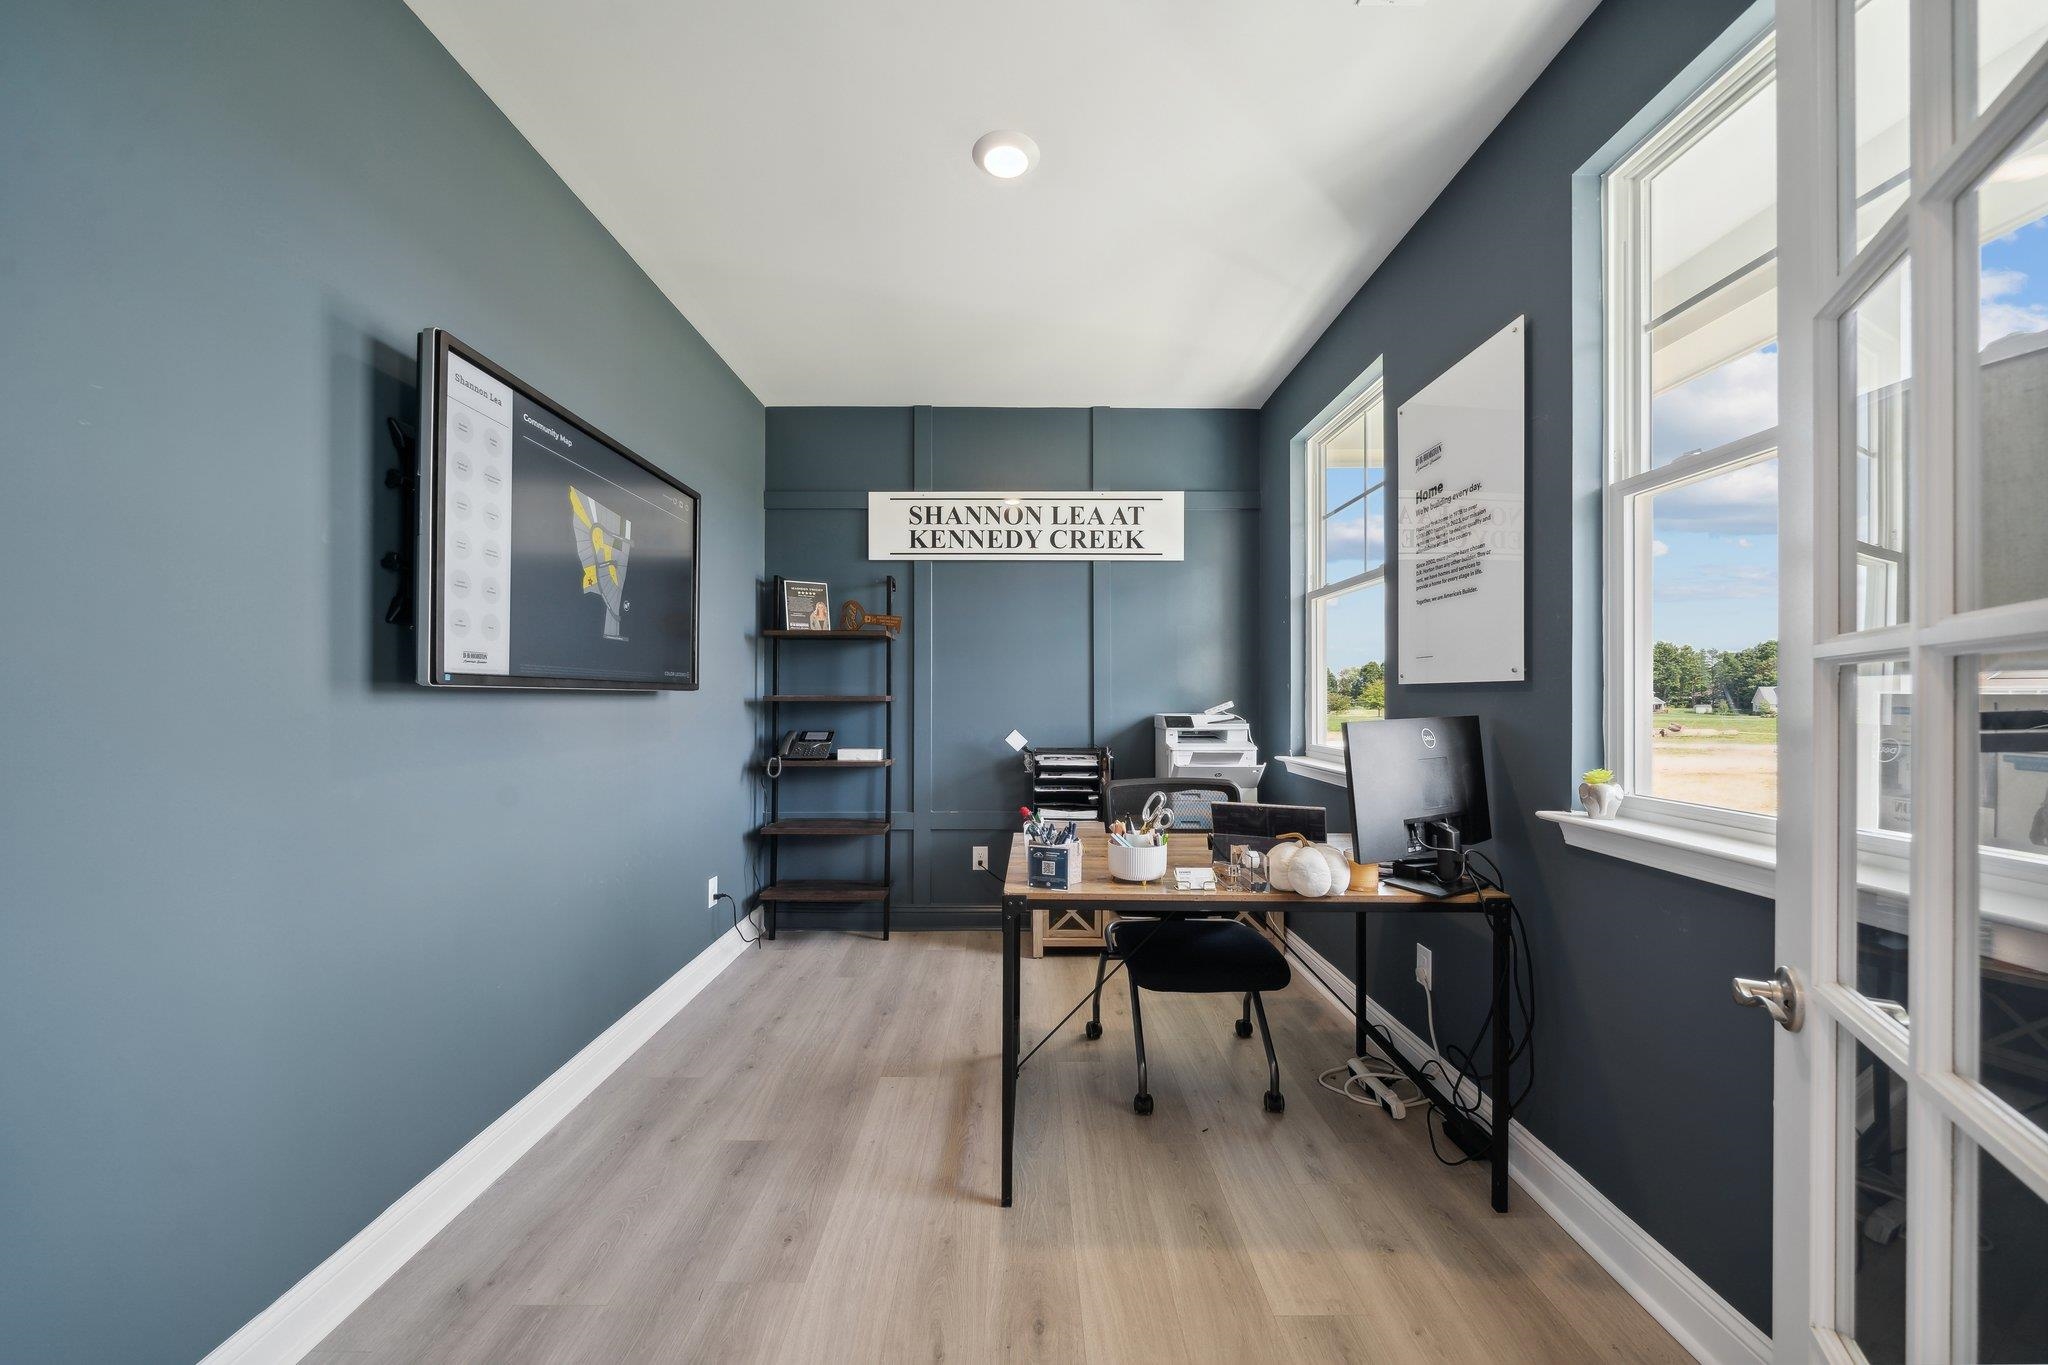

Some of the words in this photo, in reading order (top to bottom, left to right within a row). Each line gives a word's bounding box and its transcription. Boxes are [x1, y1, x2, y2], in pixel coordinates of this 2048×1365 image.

[454, 372, 489, 400] Shannon
[489, 392, 503, 407] Lea
[523, 413, 560, 441] Community
[559, 432, 573, 448] Map
[1415, 483, 1444, 504] Home
[1430, 497, 1451, 511] building
[1452, 488, 1469, 501] every
[1469, 482, 1482, 493] day.
[908, 504, 1042, 526] SHANNON
[1050, 505, 1104, 525] LEA
[1110, 505, 1145, 525] AT
[908, 529, 1043, 549] KENNEDY
[1049, 529, 1145, 550] CREEK
